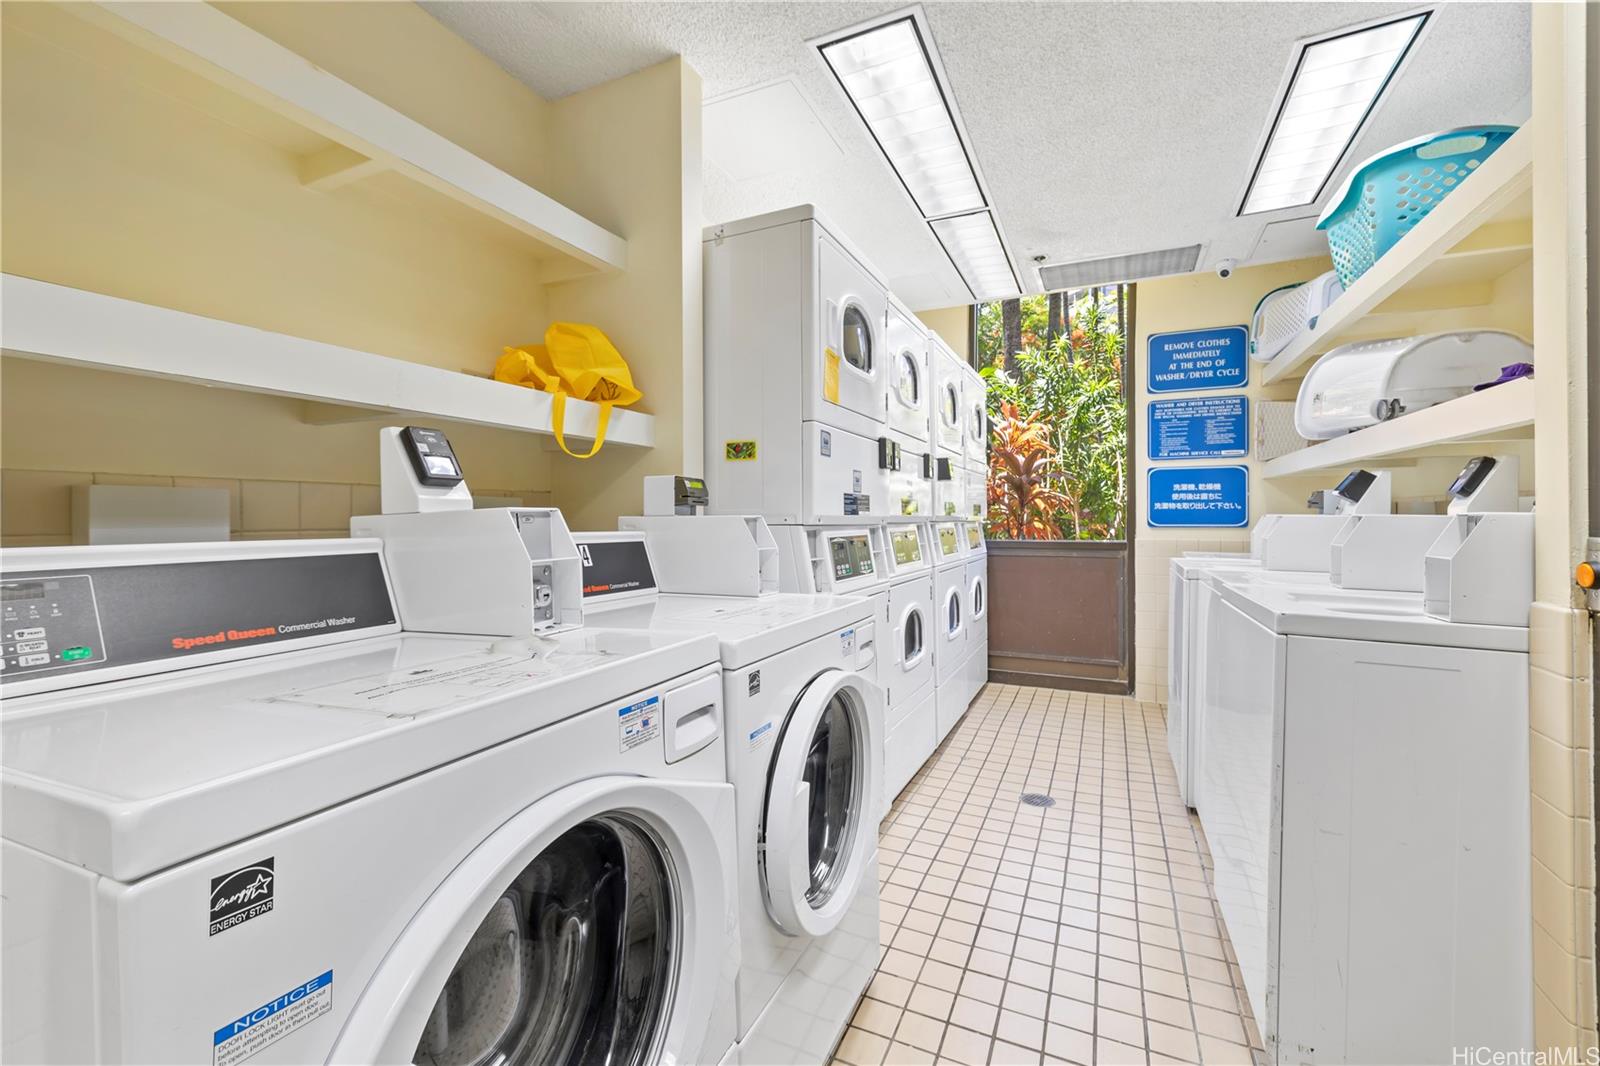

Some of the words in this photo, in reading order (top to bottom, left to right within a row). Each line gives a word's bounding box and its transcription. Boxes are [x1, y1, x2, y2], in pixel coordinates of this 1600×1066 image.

[1164, 342, 1194, 351] REMOVE
[1197, 338, 1231, 348] CLOTHES
[1172, 349, 1221, 360] IMMEDIATELY
[1180, 361, 1194, 369] THE
[1196, 360, 1212, 368] END
[1215, 359, 1226, 367] OF
[1216, 368, 1240, 377] CYCLE
[172, 631, 226, 649] Speed
[228, 627, 276, 642] Queen
[278, 620, 326, 634] Commercial
[327, 616, 356, 628] Washer
[210, 911, 248, 935] ENERGY
[249, 901, 273, 918] STAR
[233, 978, 320, 1034] NOTICE
[218, 1033, 243, 1053] DOOR
[244, 1021, 265, 1039] LOCK
[267, 1008, 288, 1026] LIGHT
[290, 998, 306, 1012] must
[316, 988, 326, 998] out
[287, 1008, 304, 1022] open
[268, 1027, 283, 1041] door
